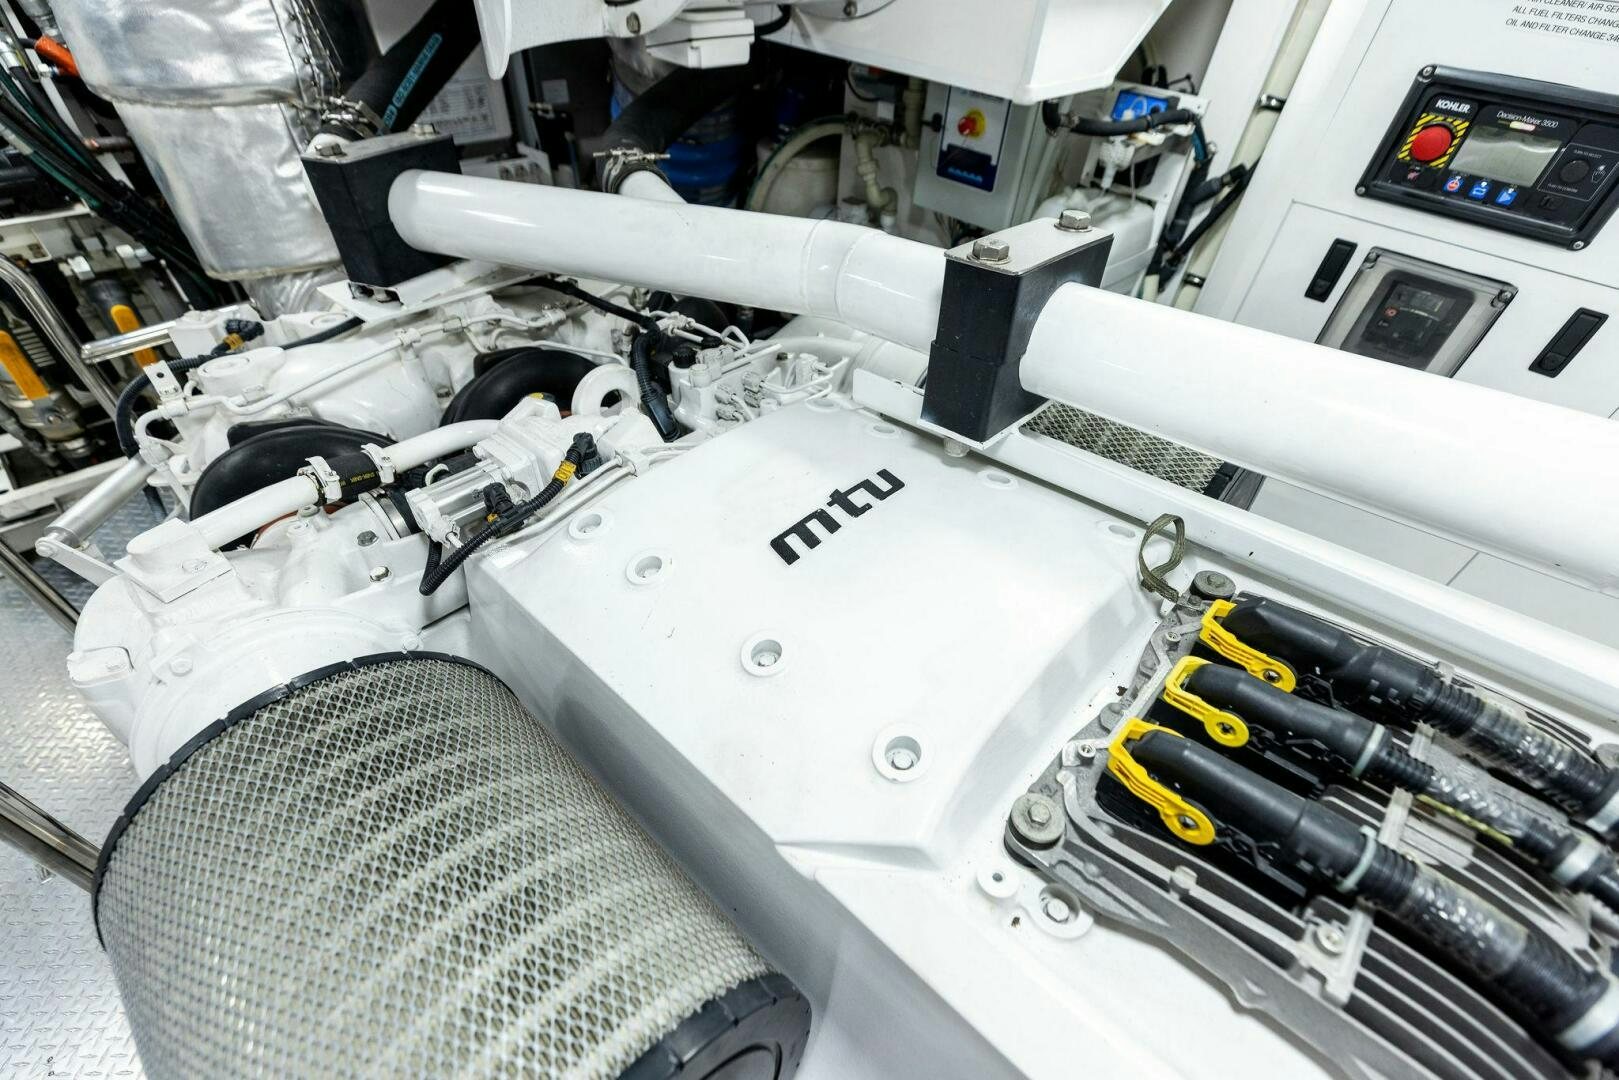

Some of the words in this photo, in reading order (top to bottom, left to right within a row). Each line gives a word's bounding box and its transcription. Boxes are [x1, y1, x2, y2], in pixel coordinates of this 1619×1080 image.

[1512, 5, 1527, 14] ALL
[1528, 7, 1549, 17] FUEL
[1552, 11, 1587, 22] FILTERS
[1587, 2, 1604, 11] AIR
[1505, 18, 1518, 27] OIL
[1520, 20, 1539, 30] AND
[1539, 22, 1569, 34] FILTER
[1569, 27, 1607, 41] CHANGE
[1435, 99, 1471, 114] KOHLER
[770, 468, 905, 565] mtu
